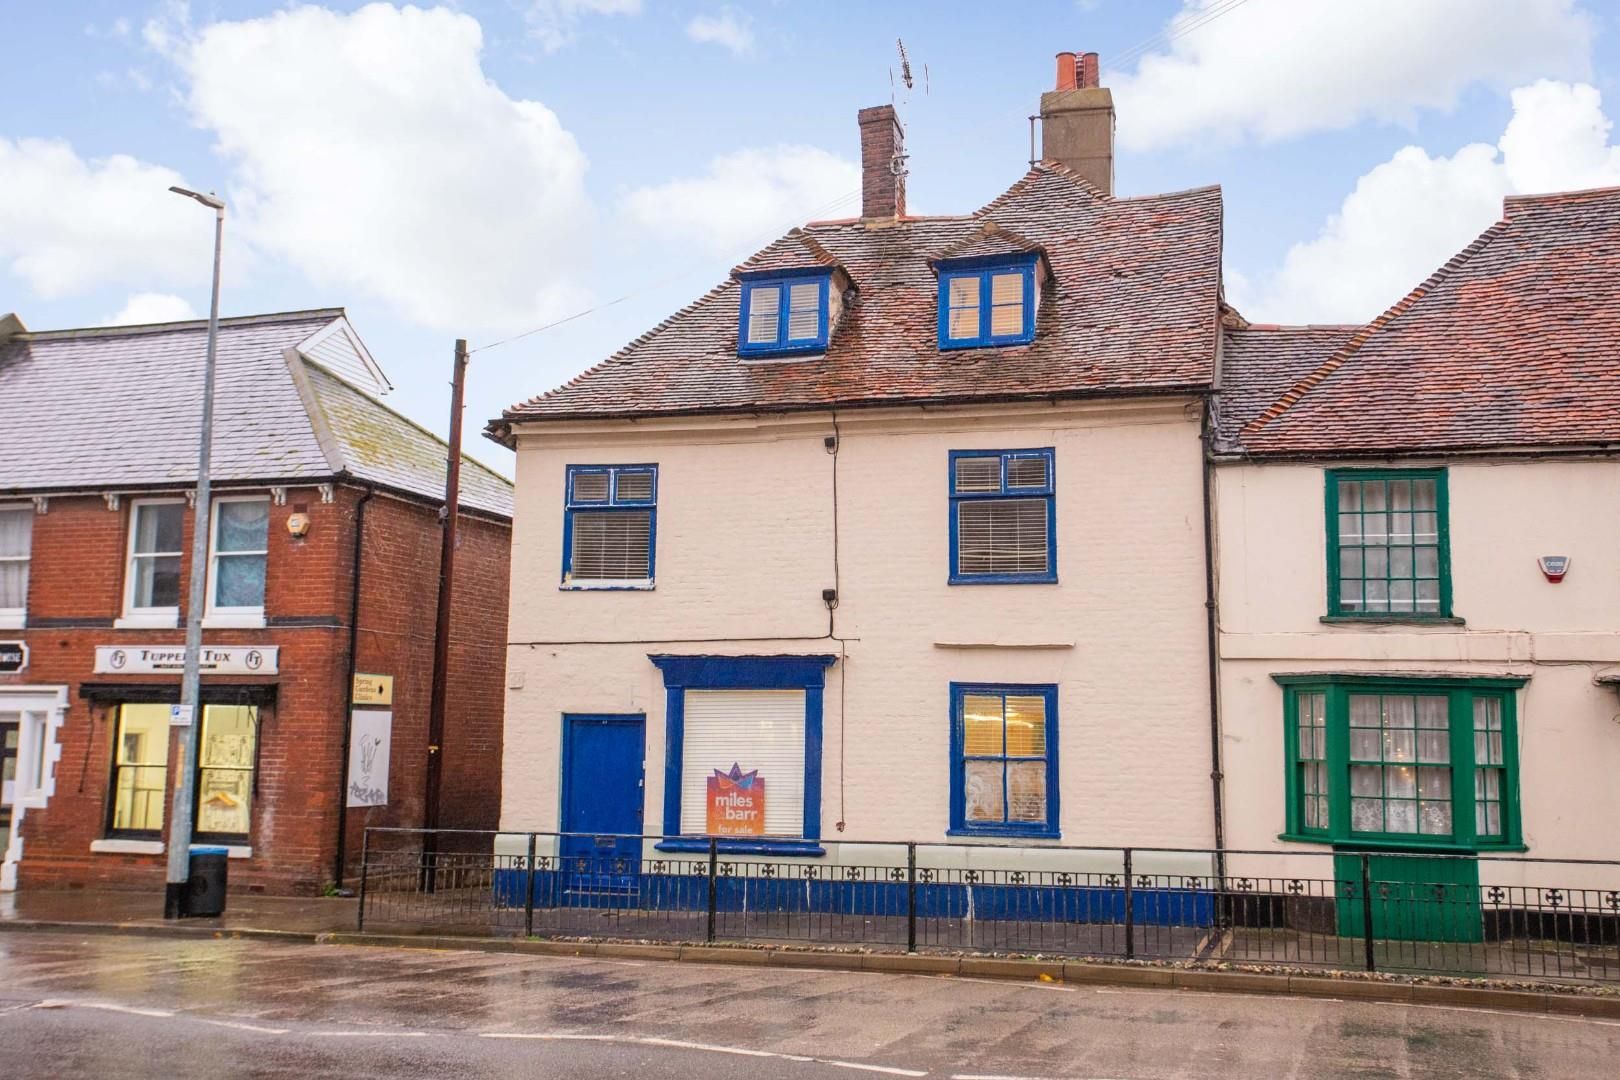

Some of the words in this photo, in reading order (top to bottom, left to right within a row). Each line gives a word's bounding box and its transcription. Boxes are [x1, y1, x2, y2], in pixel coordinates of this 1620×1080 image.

[204, 650, 231, 661] TUX
[715, 792, 753, 807] miles
[725, 806, 758, 820] barr
[718, 824, 732, 834] for
[735, 824, 753, 834] sale
